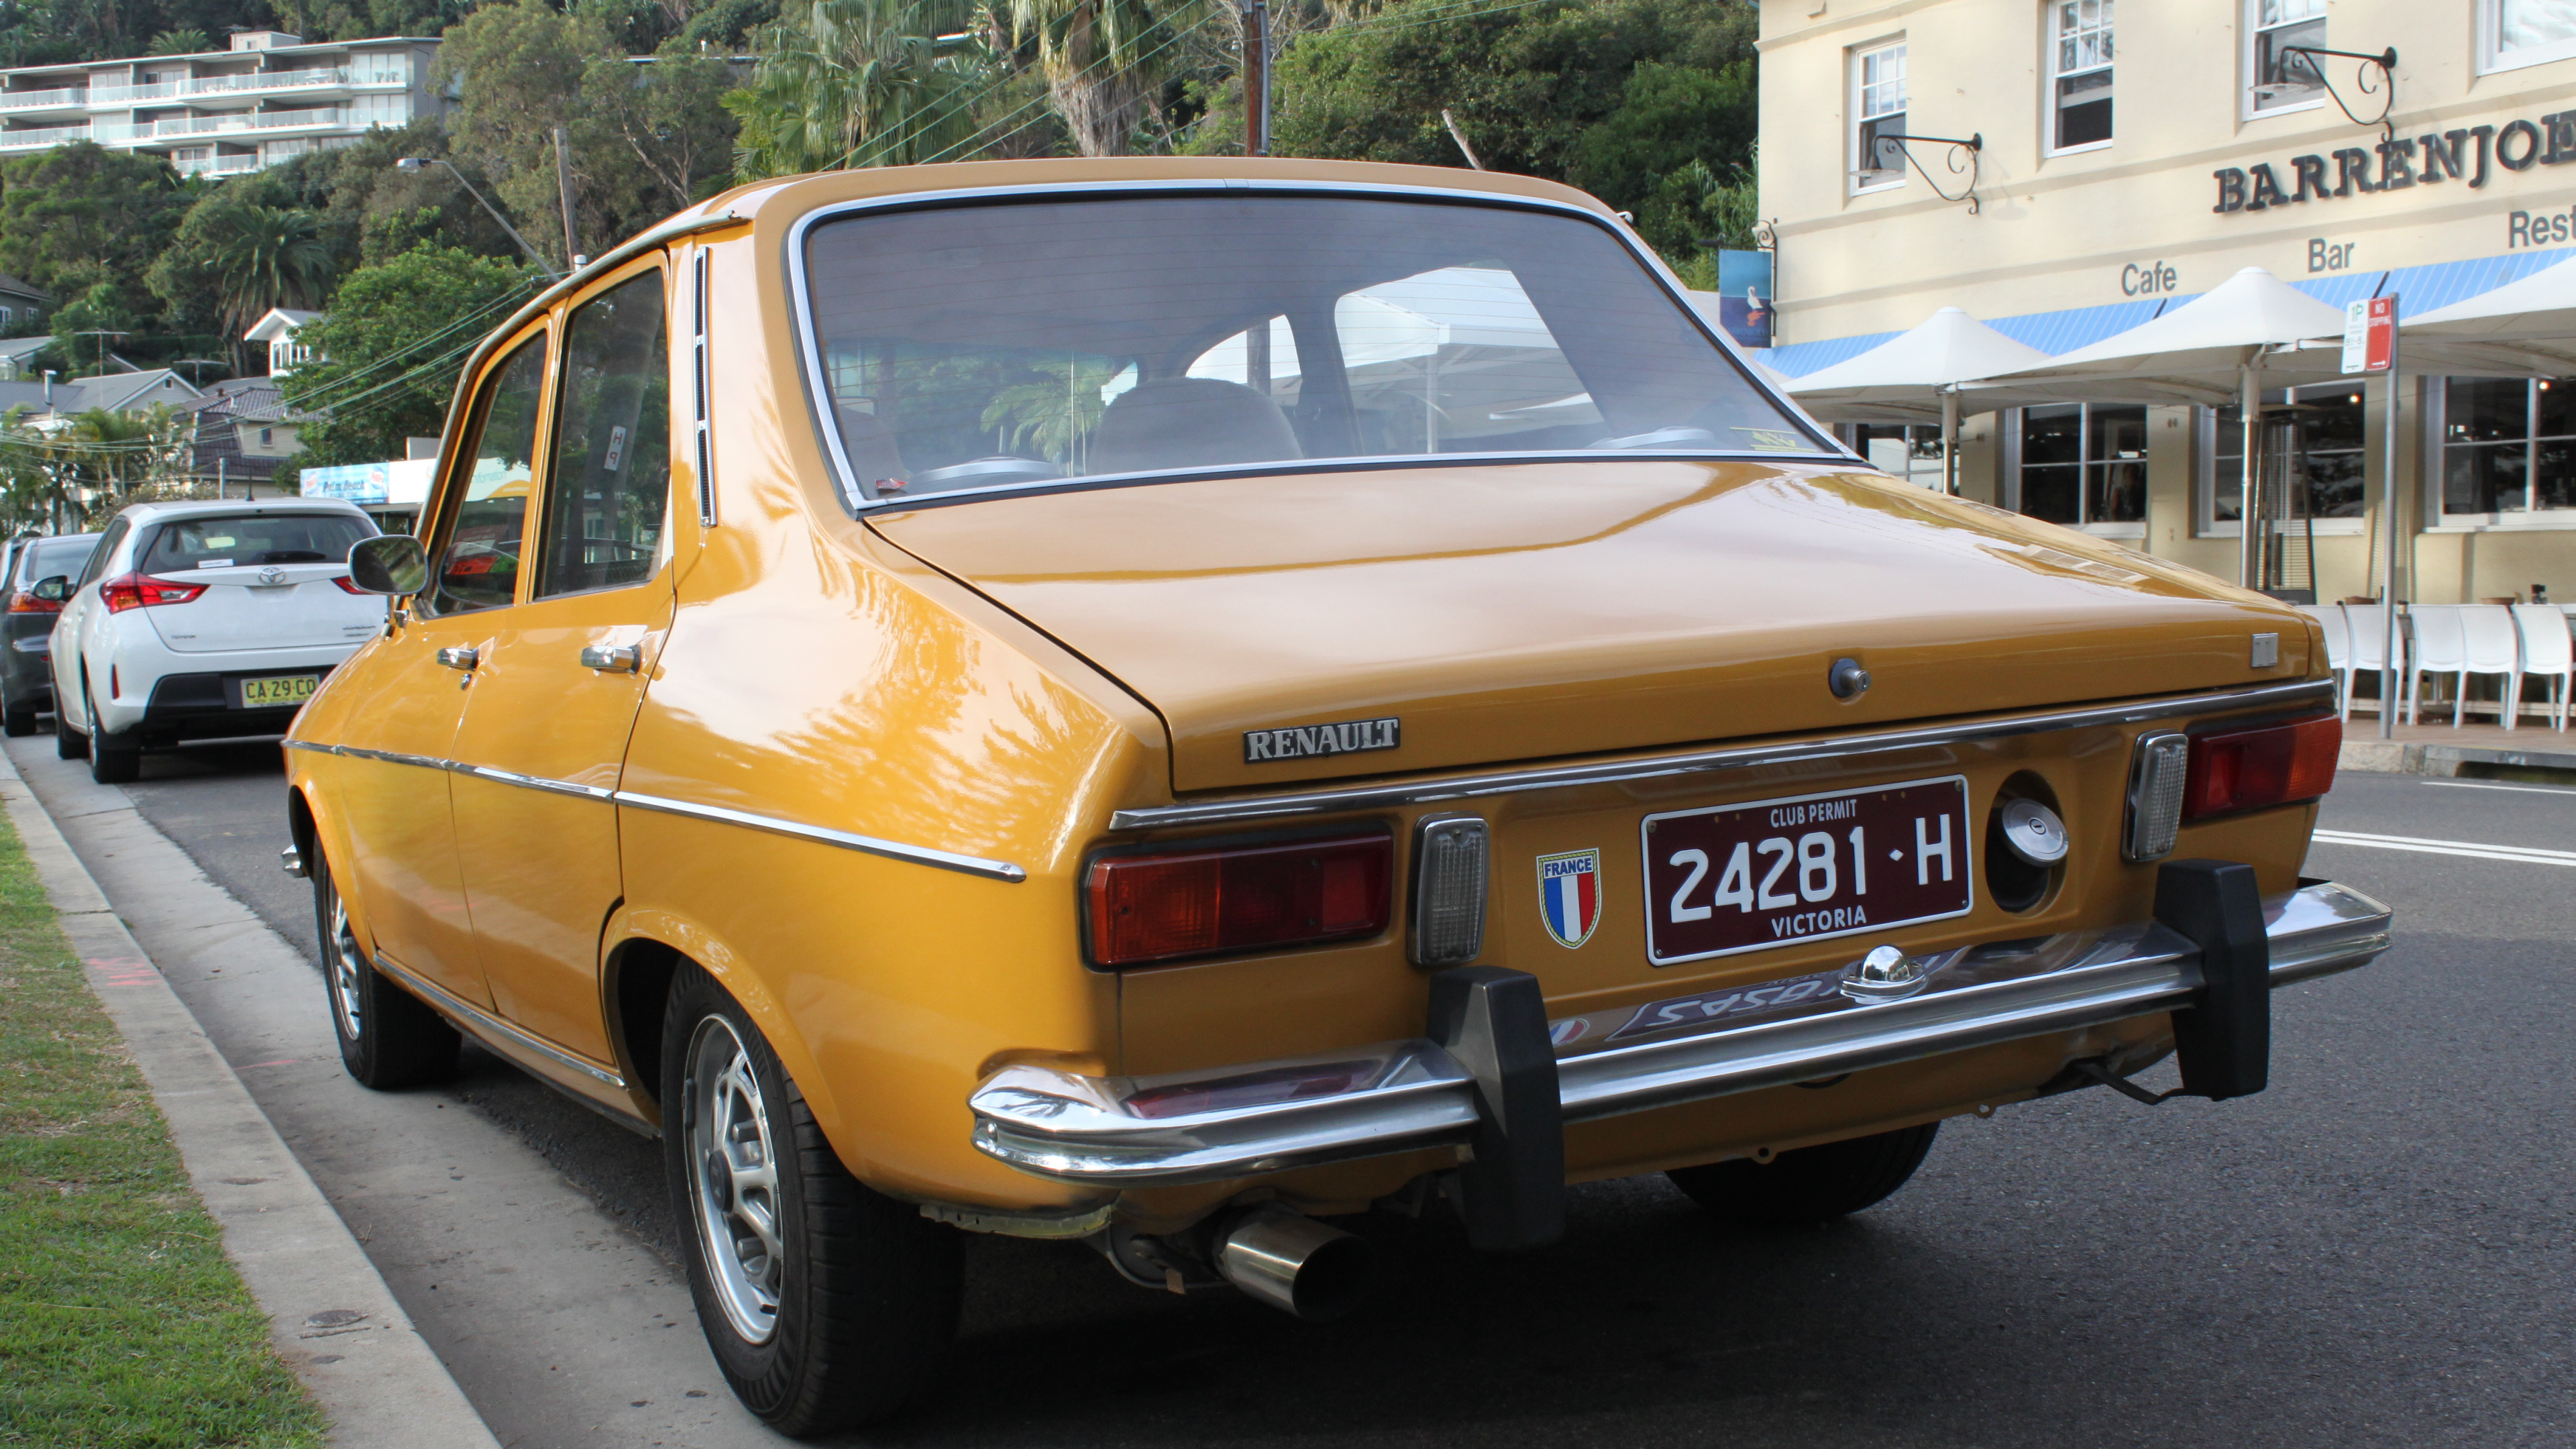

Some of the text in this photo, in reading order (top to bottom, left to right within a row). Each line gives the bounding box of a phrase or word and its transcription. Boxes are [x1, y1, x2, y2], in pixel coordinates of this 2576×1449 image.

[2213, 108, 2576, 213] BARRENJOE
[2121, 260, 2177, 297] Cafe
[2308, 237, 2355, 273] Bar
[2369, 315, 2391, 327] STOPPING
[2375, 302, 2385, 315] NO
[323, 480, 364, 492] Palm Beach
[1247, 718, 1398, 760] RENAULT
[1770, 799, 1857, 828] CLUB PERMIT
[1544, 857, 1592, 877] FRANCE
[1771, 905, 1867, 937] VICTORIA
